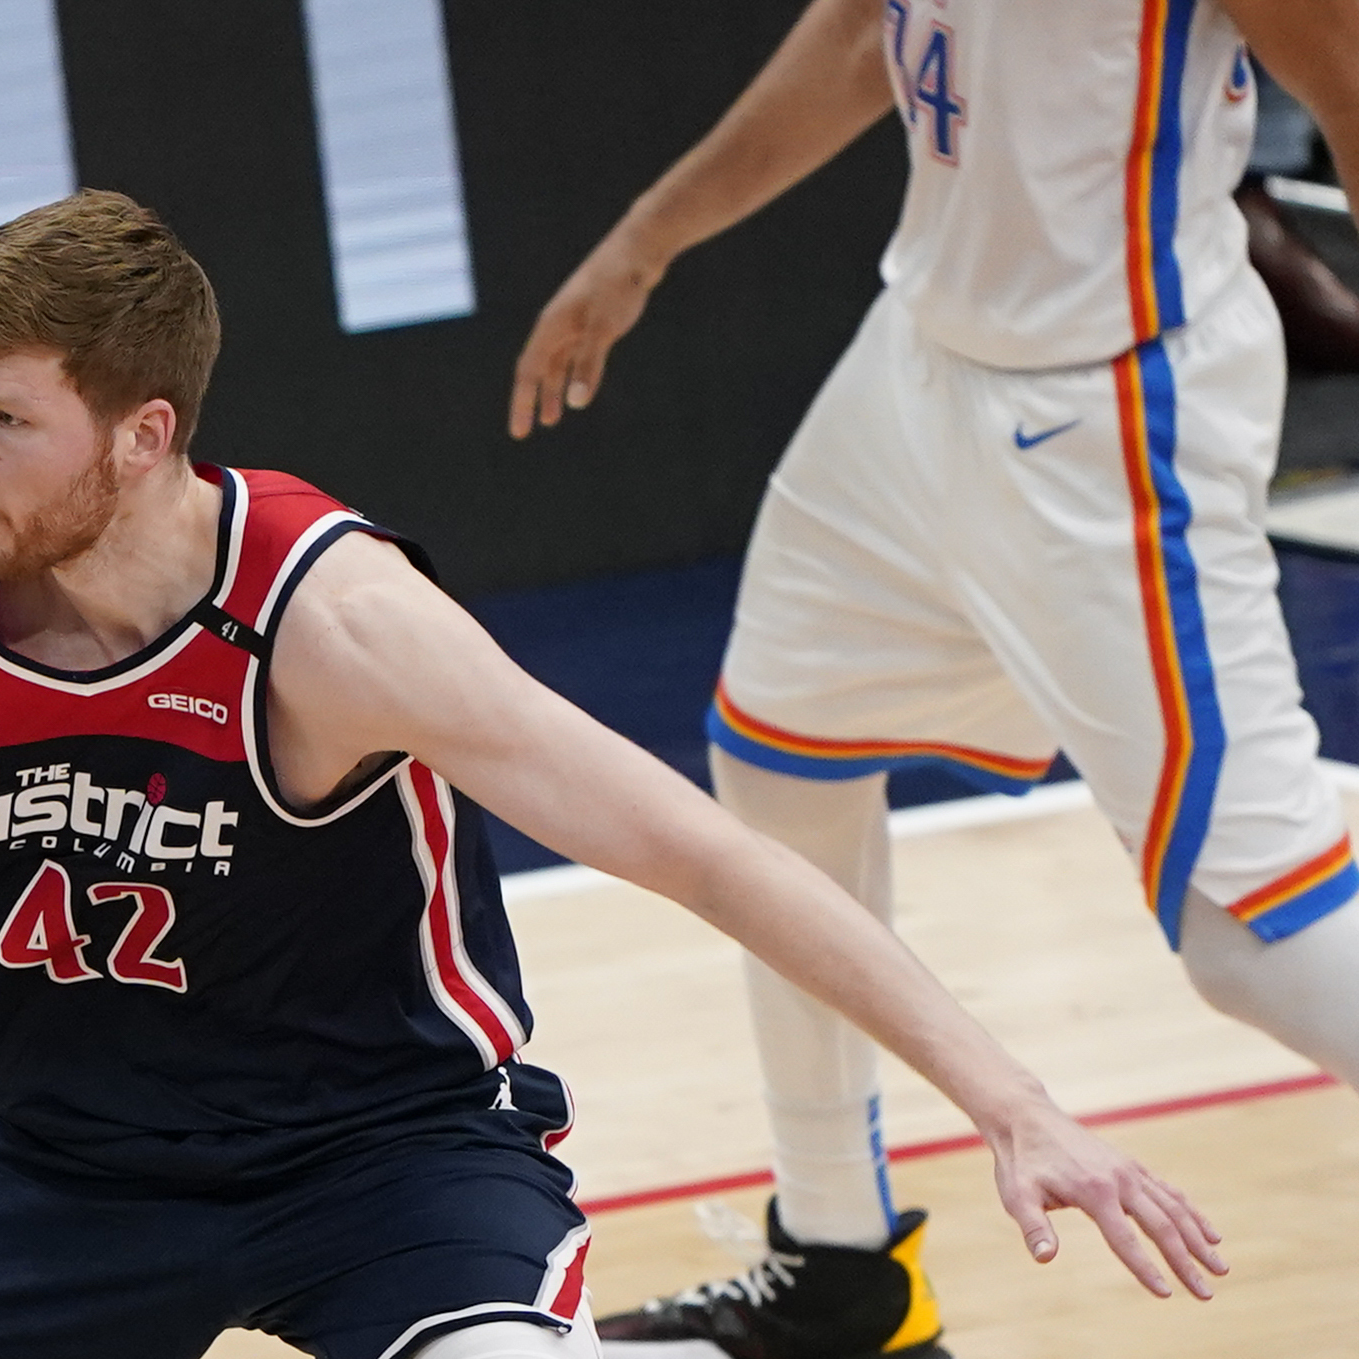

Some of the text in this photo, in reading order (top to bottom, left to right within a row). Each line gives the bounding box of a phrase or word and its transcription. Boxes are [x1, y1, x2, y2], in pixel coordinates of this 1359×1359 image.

[221, 620, 239, 642] 41
[147, 692, 229, 725] GEICO
[16, 762, 71, 787] THE
